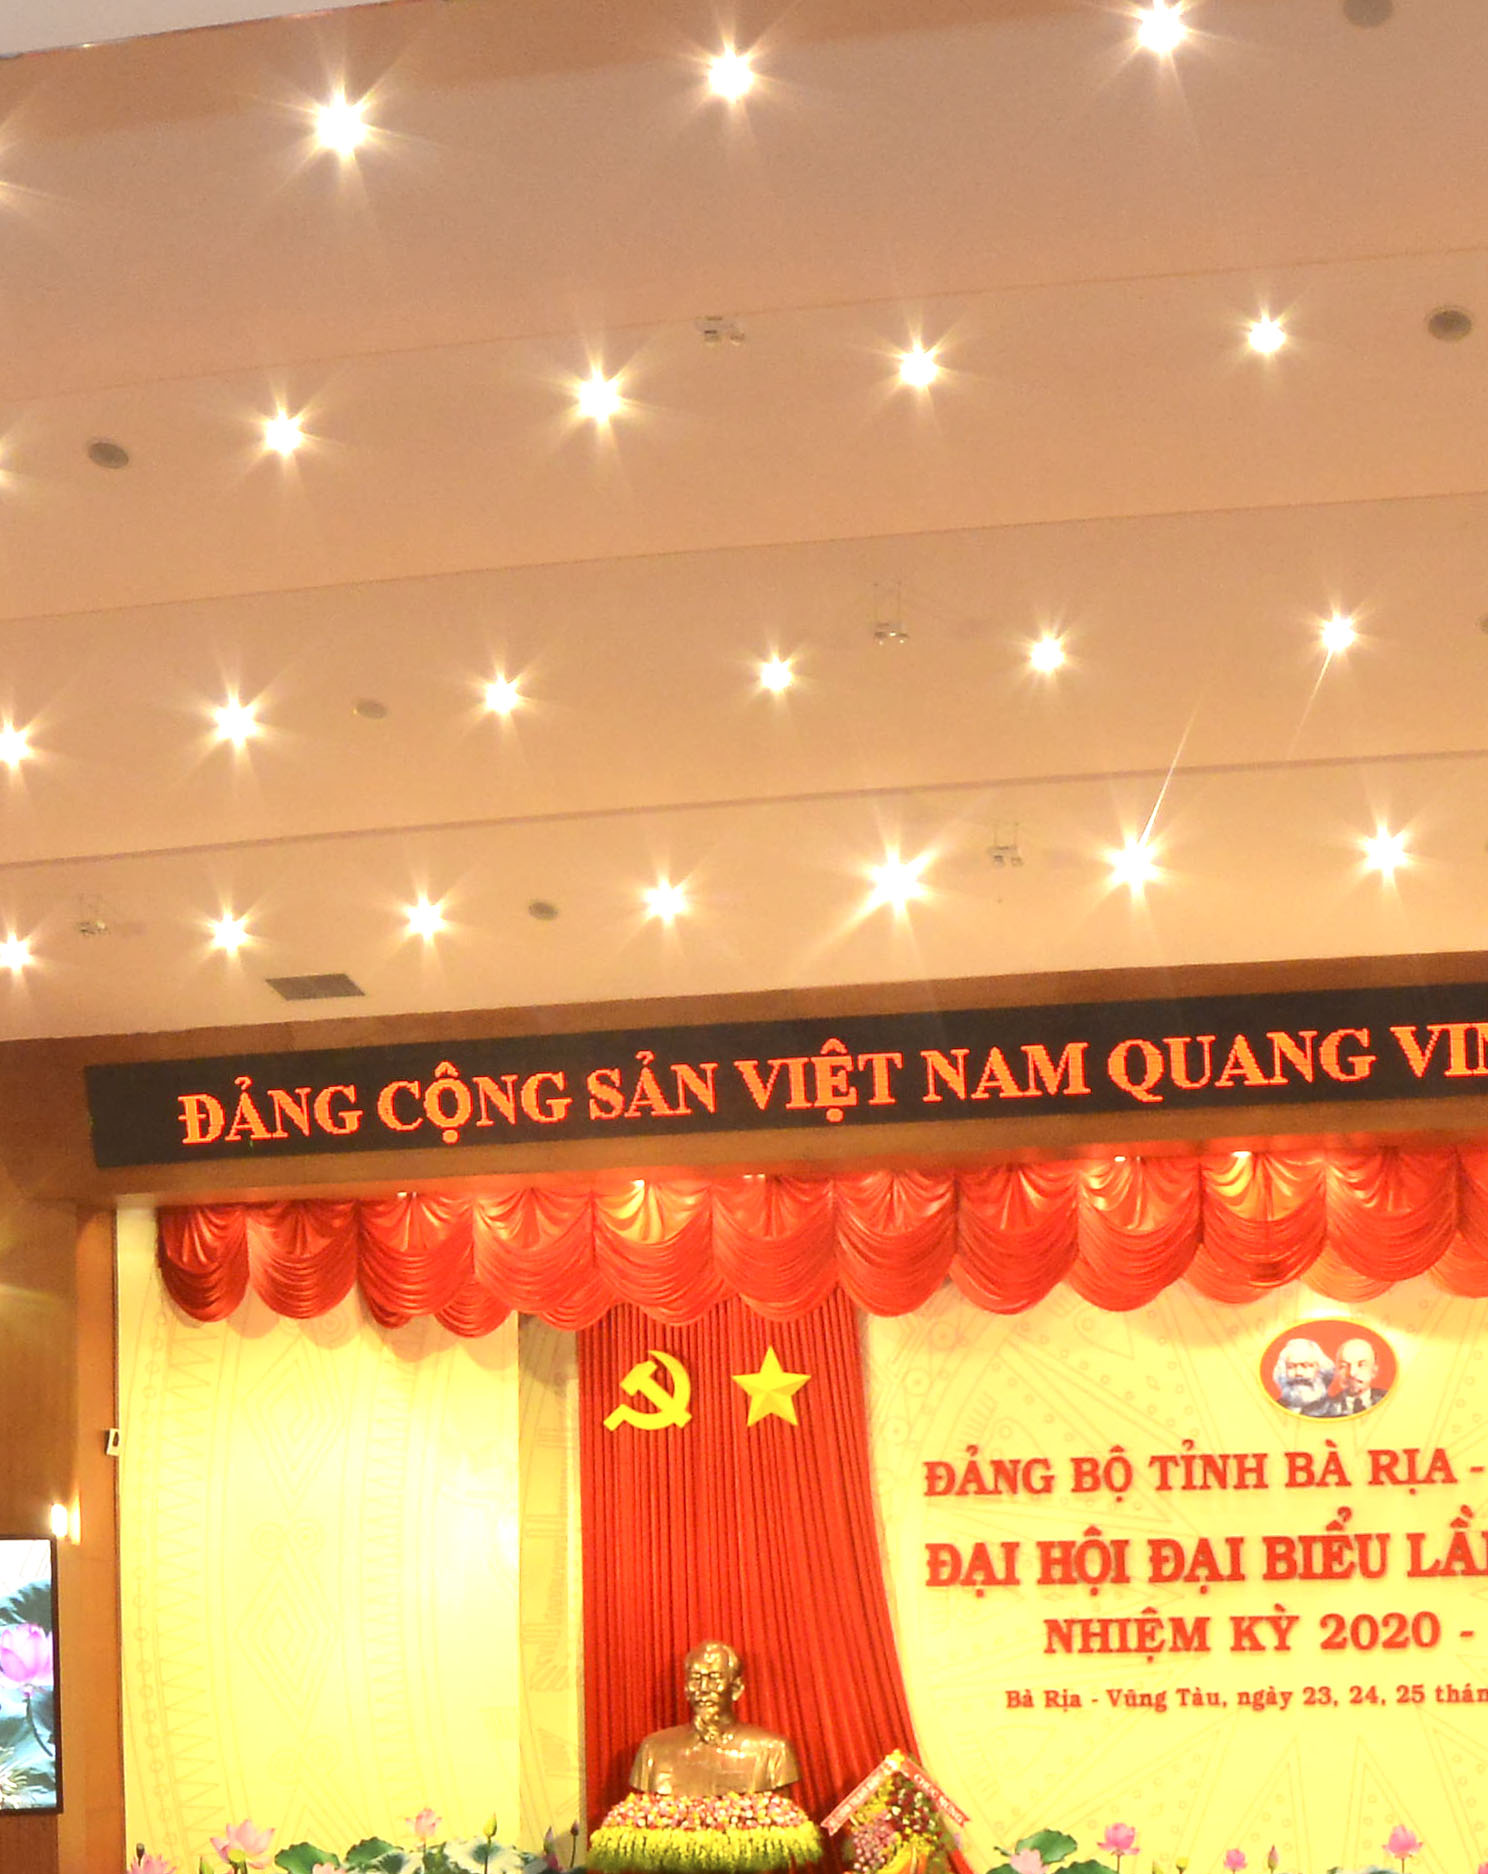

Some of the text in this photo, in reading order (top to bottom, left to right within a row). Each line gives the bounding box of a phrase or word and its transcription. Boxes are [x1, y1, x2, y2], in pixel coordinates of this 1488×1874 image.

[179, 1077, 364, 1145] ĐẢNG
[378, 1062, 574, 1146] CỘNG
[588, 1052, 719, 1121] SẢN
[735, 1039, 904, 1123] VIỆT
[921, 1043, 1092, 1103] NAM
[1109, 1029, 1377, 1104] QUANG
[925, 1446, 1056, 1498] ĐẢNG
[1071, 1446, 1134, 1504] BỘ
[1149, 1440, 1270, 1493] TỈNH
[1285, 1440, 1353, 1489] BÀ
[1369, 1449, 1459, 1496] RỊA
[926, 1543, 1021, 1599] ĐẠI
[1037, 1526, 1132, 1597] HỘI
[1148, 1537, 1248, 1596] ĐẠI
[1263, 1507, 1392, 1582] BIỂU
[1045, 1607, 1212, 1664] NHIỆM
[1231, 1604, 1301, 1653] KỲ
[1321, 1612, 1442, 1652] 2020
[1007, 1690, 1035, 1709] Bà
[1045, 1690, 1083, 1713] Rịa
[1107, 1690, 1168, 1714] Vũng
[1177, 1688, 1228, 1708] Tàu,
[1238, 1687, 1294, 1713] ngày
[1304, 1687, 1339, 1707] 23,
[1351, 1687, 1387, 1706] 24,
[1397, 1685, 1426, 1705] 25
